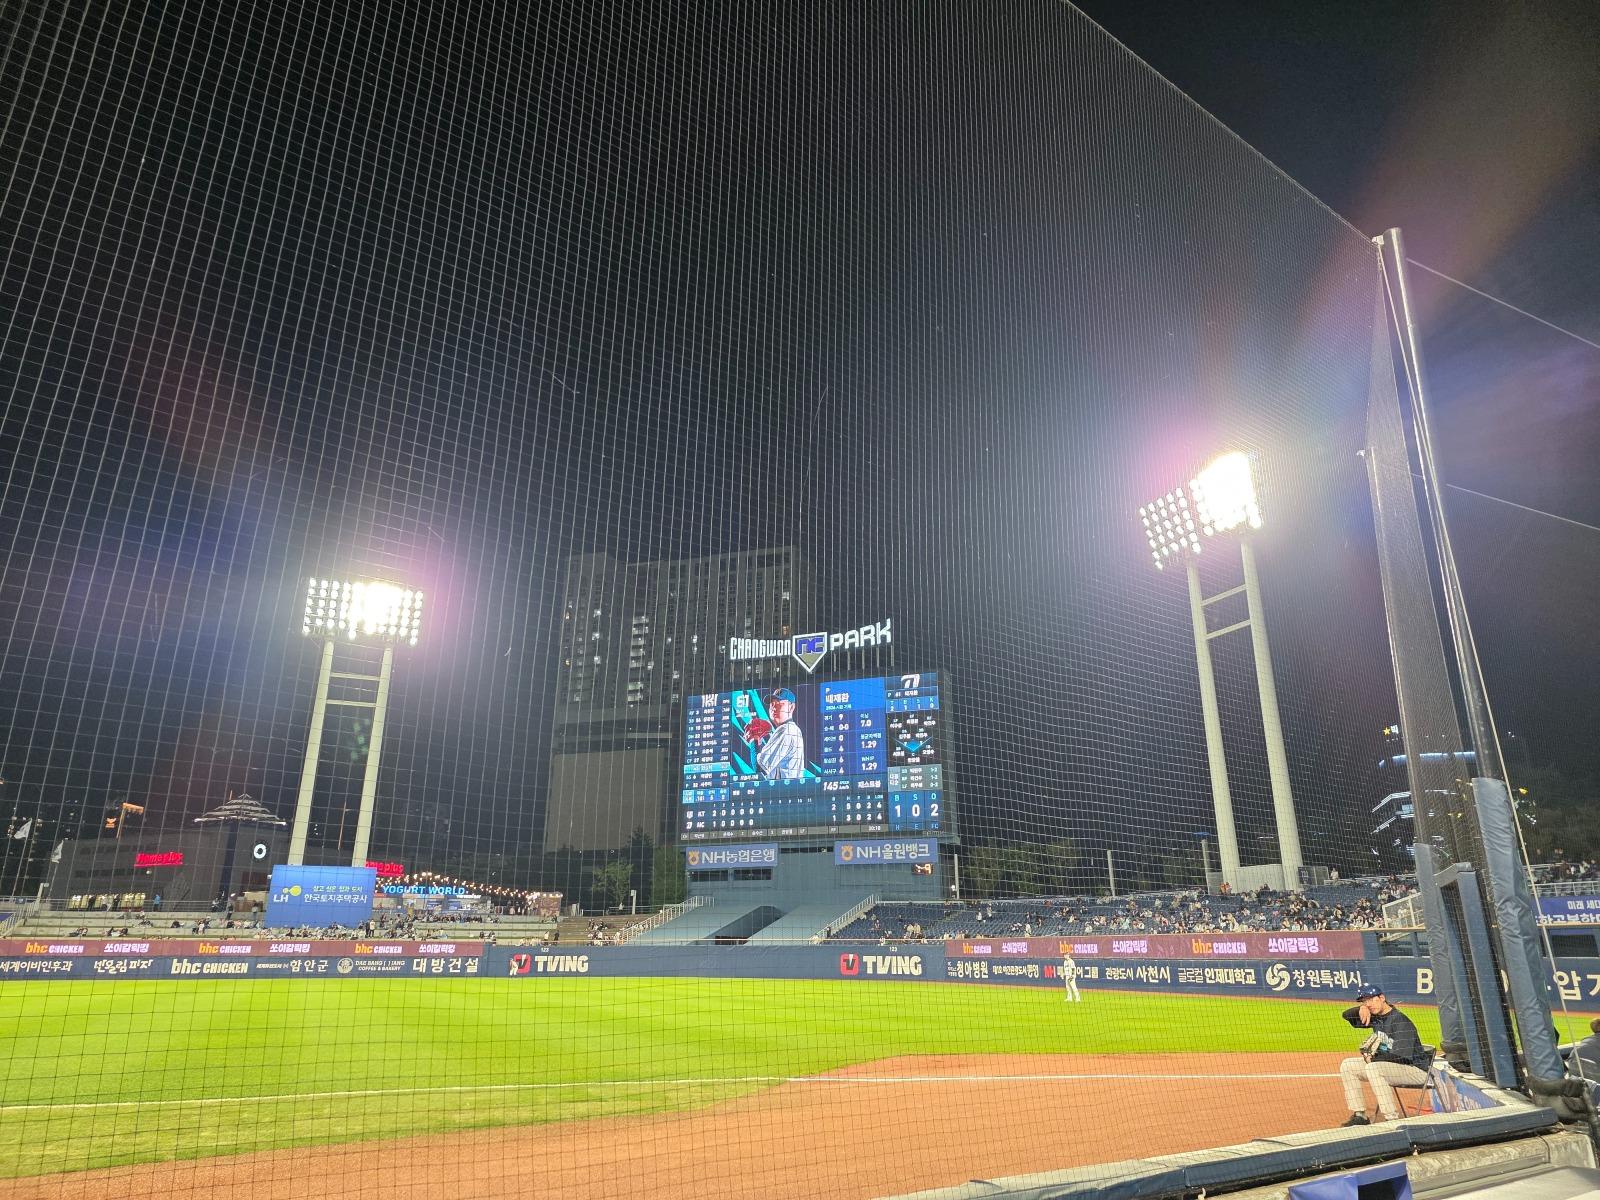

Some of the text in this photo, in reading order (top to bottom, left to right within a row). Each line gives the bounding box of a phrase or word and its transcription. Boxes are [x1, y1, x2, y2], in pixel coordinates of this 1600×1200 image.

[730, 637, 791, 660] CHANGWON
[830, 618, 891, 650] PARK
[862, 740, 877, 748] 1.29
[861, 762, 877, 770] 1.29
[823, 782, 839, 790] 145
[895, 804, 939, 818] 1 0 2
[701, 848, 776, 864] NH농협은행
[857, 843, 930, 860] NH올원뱅크
[383, 886, 465, 894] YOGURT WORLD
[273, 894, 288, 902] LH
[304, 893, 368, 904] 한국토지주택공사
[25, 942, 48, 954] bhc
[48, 945, 84, 954] CHICKEN
[199, 943, 218, 954] bhc
[219, 945, 251, 954] CHICKEN
[355, 943, 373, 954] bhc
[373, 945, 402, 954] CHICKEN
[1060, 941, 1073, 954] bhc
[1074, 943, 1098, 954] CHICKEN
[1192, 937, 1319, 954] bhc CHICKEN 쏘이갈릭킹
[0, 961, 73, 972] 세계이비인후과
[129, 959, 153, 969] 피자
[171, 959, 249, 974] bhc CHICKEN
[412, 957, 479, 973] 대방건설
[535, 955, 589, 972] TVING
[863, 955, 922, 975] TVING
[957, 961, 988, 978] 청아병원
[1105, 966, 1170, 983] 관광도시 사천시
[1178, 967, 1257, 985] 글로컬 인제대학교
[1292, 969, 1362, 988] 창원특례시
